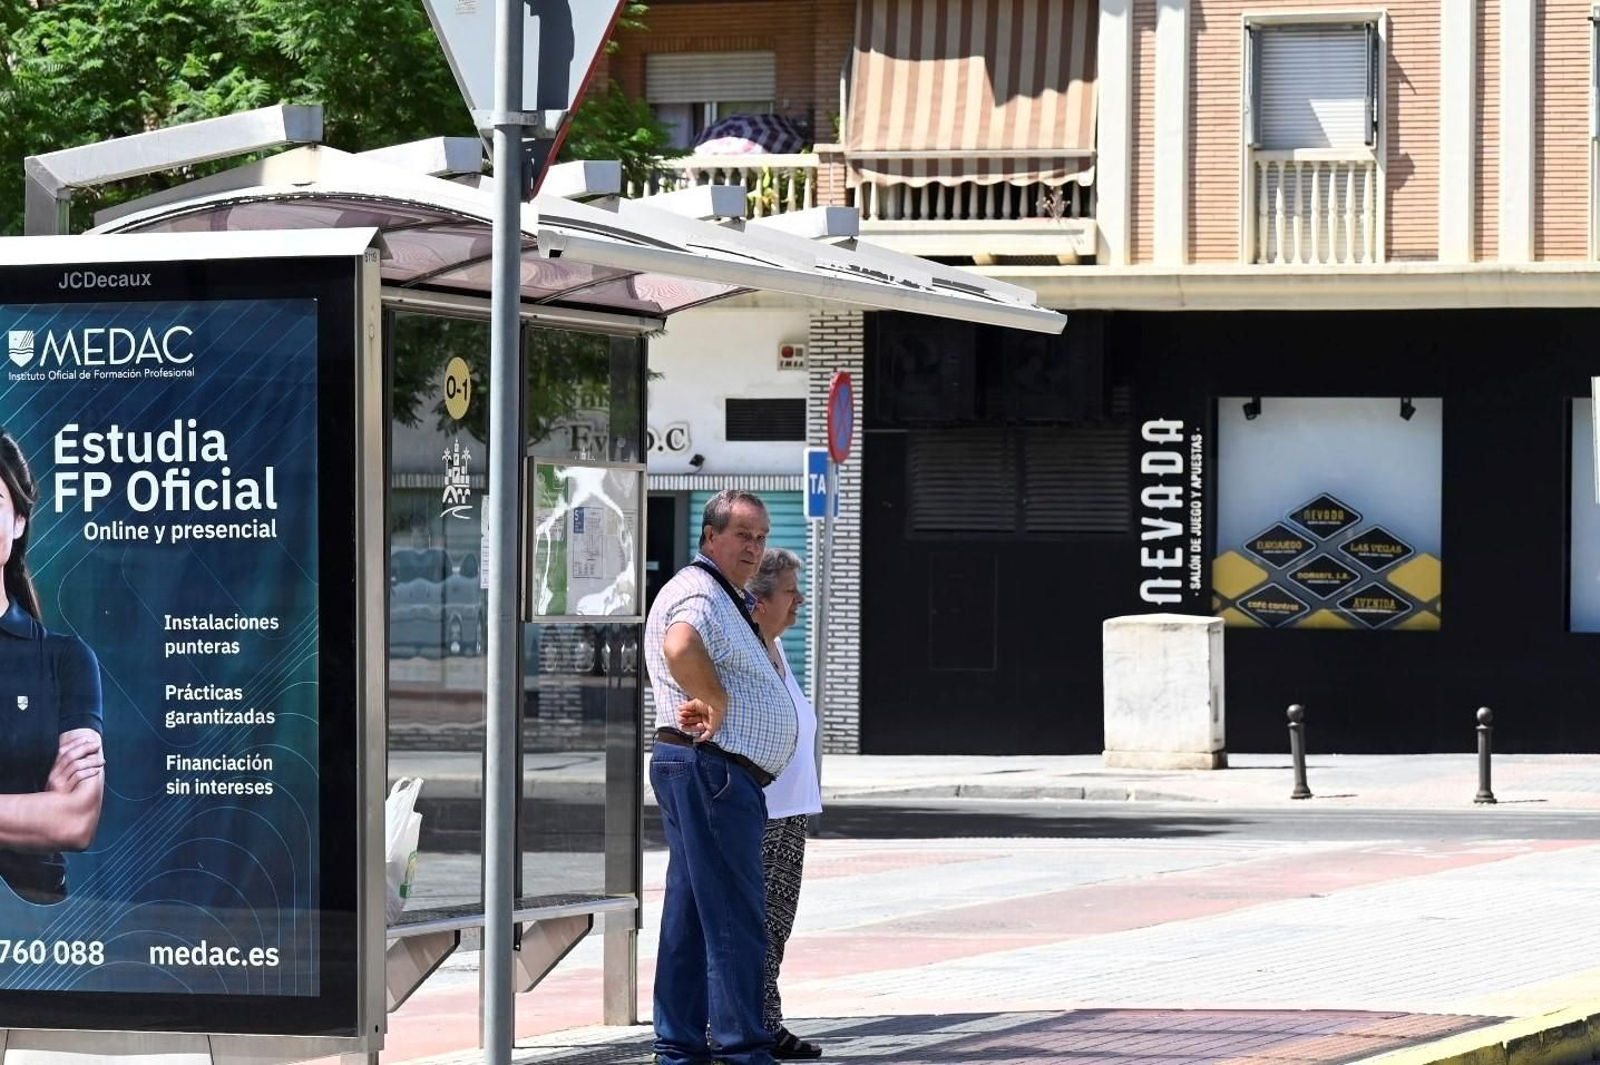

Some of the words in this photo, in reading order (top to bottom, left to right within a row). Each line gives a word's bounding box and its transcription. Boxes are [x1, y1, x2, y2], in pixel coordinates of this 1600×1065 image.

[58, 271, 152, 289] JCDecaux
[40, 326, 194, 366] MEDAC
[8, 371, 46, 381] Instituto
[48, 370, 77, 380] Oficial
[79, 369, 91, 380] de
[94, 369, 141, 380] Formación
[144, 367, 195, 378] Profesional
[54, 418, 228, 464] Estudia
[1190, 433, 1203, 489] APUESTAS
[54, 472, 112, 513] FP
[126, 466, 278, 512] Oficial
[1190, 490, 1202, 499] Y
[1139, 417, 1184, 606] NEVADA
[1190, 500, 1202, 536] JUEGO
[84, 520, 149, 541] Online
[155, 525, 166, 544] y
[171, 518, 277, 543] presencial
[1190, 537, 1202, 553] DE
[164, 613, 279, 631] Instalaciones
[165, 639, 240, 658] punteras
[165, 684, 243, 701] Prácticas
[165, 708, 276, 729] garantizadas
[165, 754, 273, 771] Financiación
[166, 779, 190, 795] sin
[195, 778, 274, 796] intereses
[0, 939, 47, 965] 760
[53, 940, 105, 966] 088
[149, 940, 280, 967] medac.es
